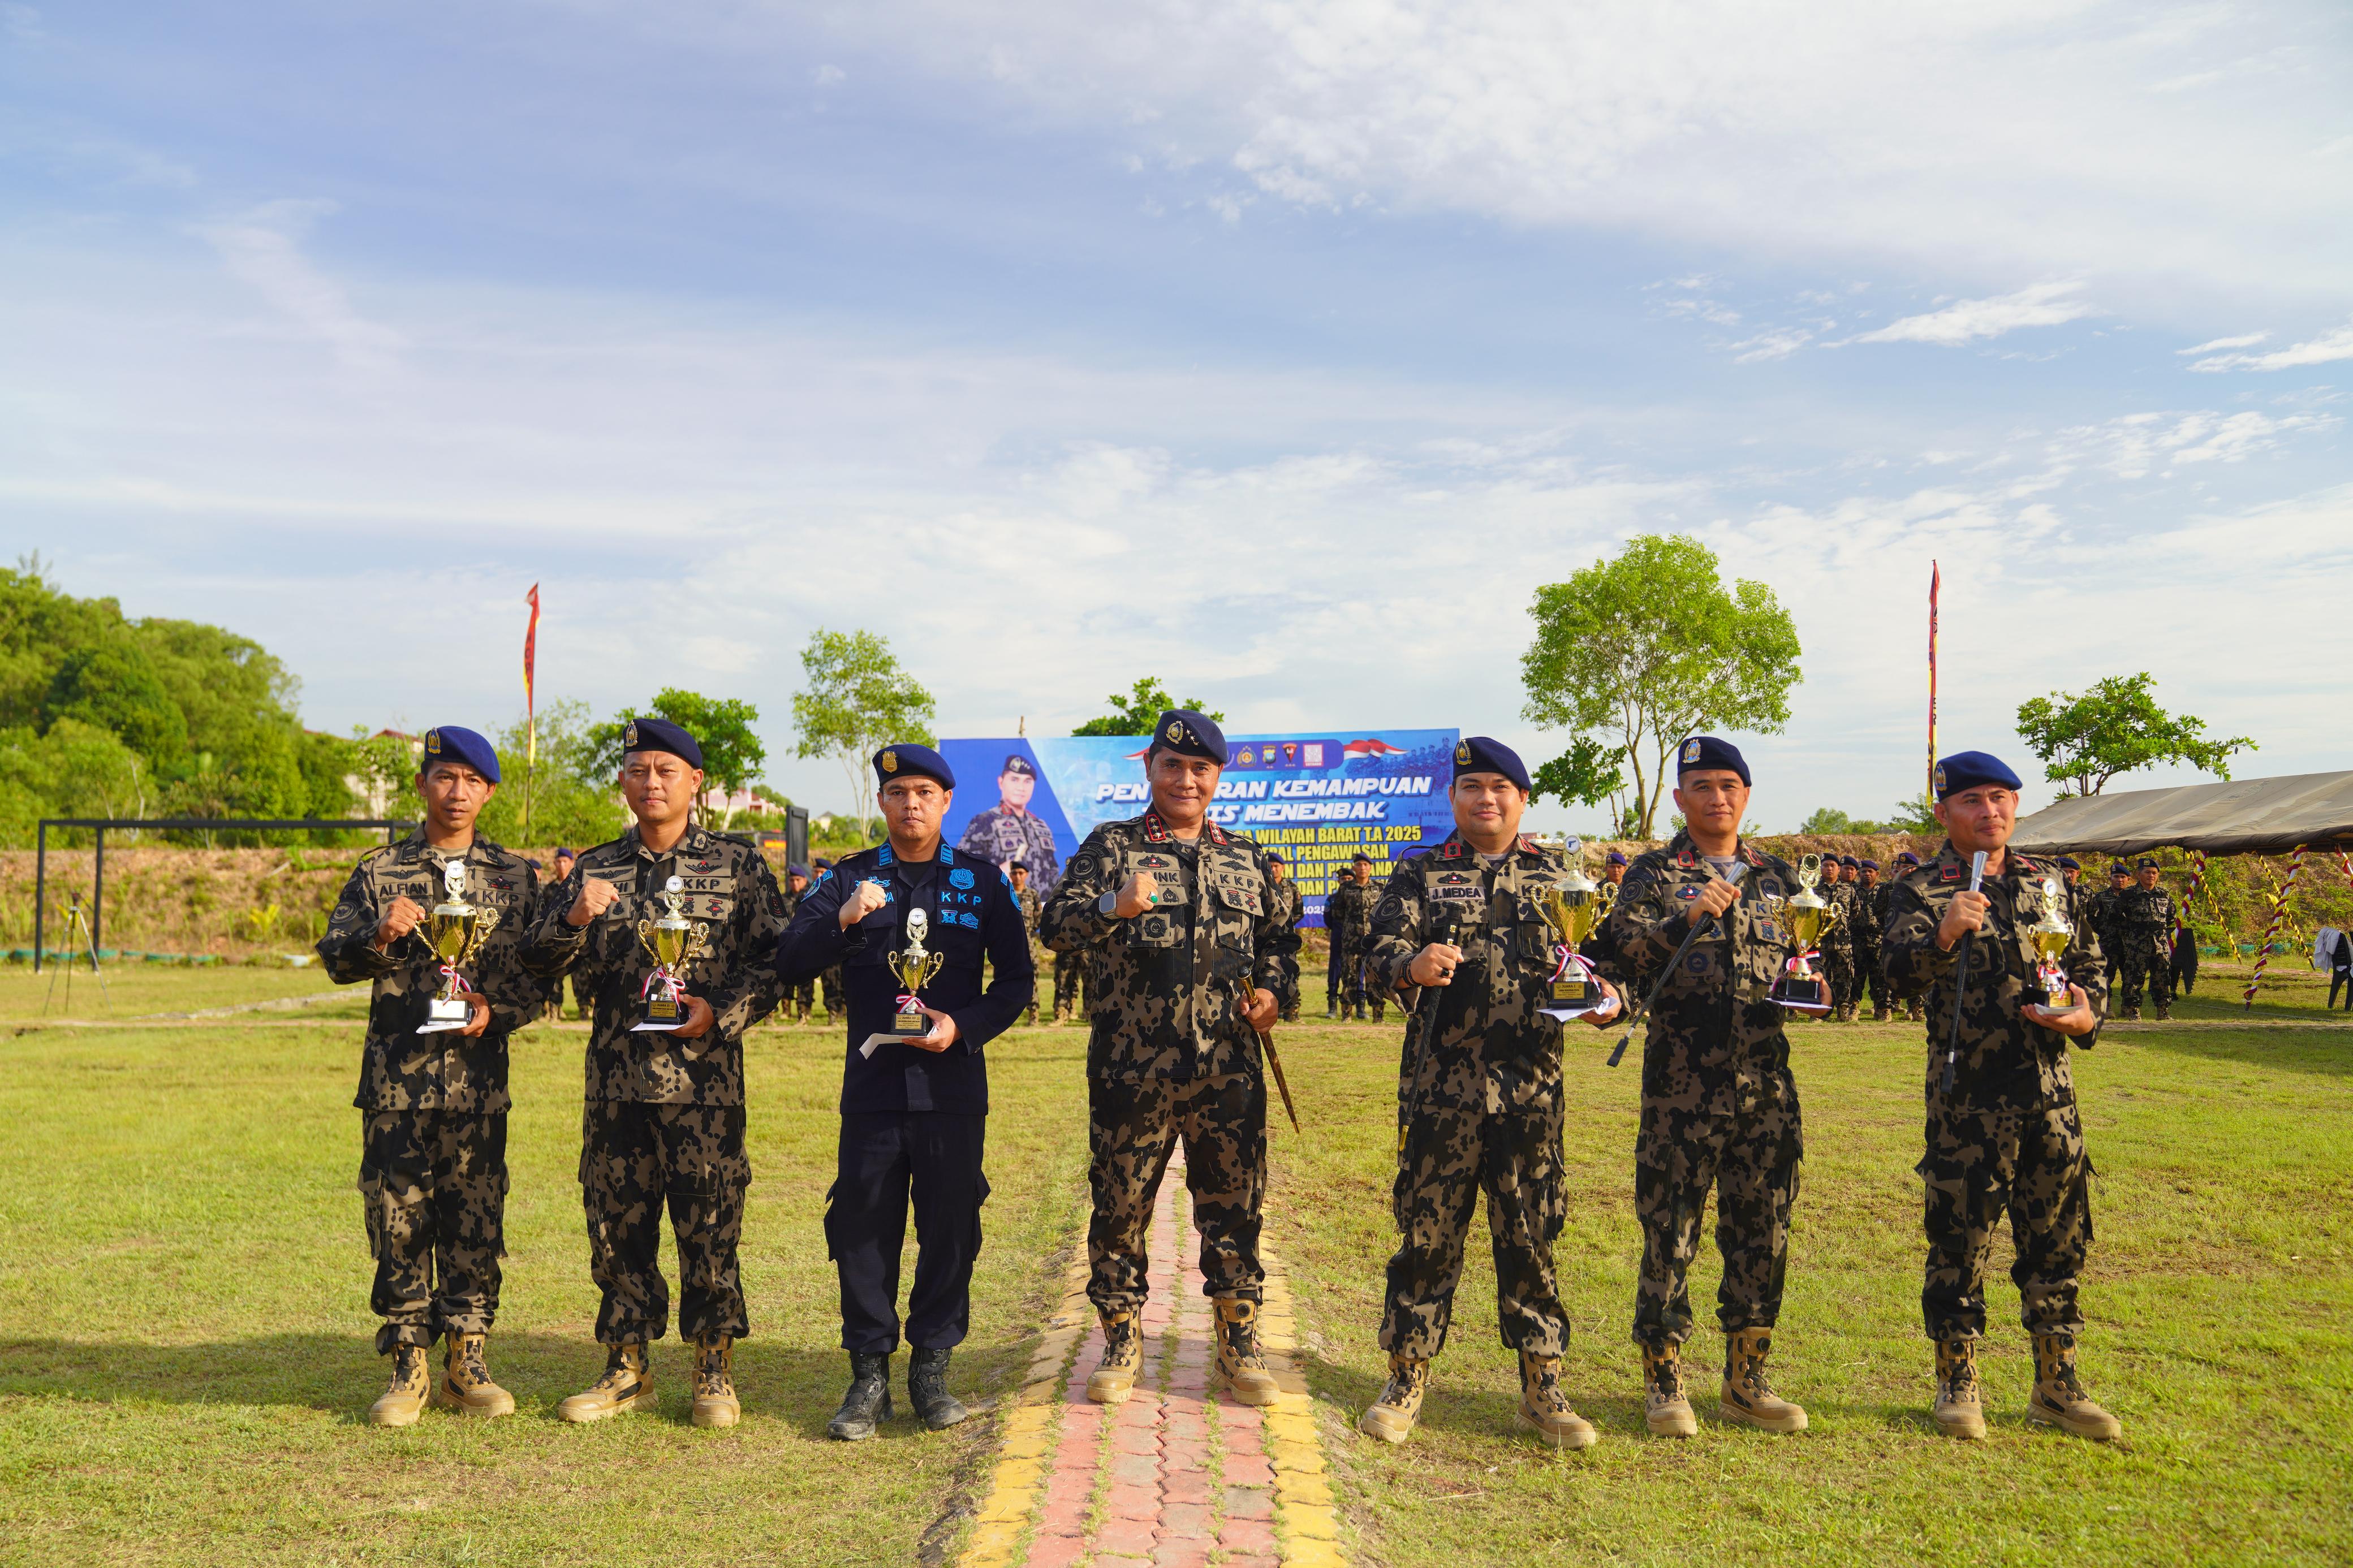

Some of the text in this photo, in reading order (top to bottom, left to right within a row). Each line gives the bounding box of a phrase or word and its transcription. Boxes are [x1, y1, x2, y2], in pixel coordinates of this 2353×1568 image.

[1272, 776, 1433, 799] KEMAMPUAN
[1244, 801, 1388, 824] MENEMBAK
[1255, 828, 1316, 844] WILAYAH
[1317, 827, 1361, 843] BARAT
[1385, 826, 1422, 841] 2025
[1296, 844, 1389, 861] PENGAWASAN
[1296, 862, 1325, 879] DAN
[683, 878, 720, 889] KKP
[1219, 874, 1254, 889] KKP
[1297, 880, 1325, 896] DAN
[379, 882, 428, 897] ALFIAN
[482, 890, 519, 904] KKP
[1432, 886, 1481, 900] J.MEDEA
[941, 891, 982, 906] KKP
